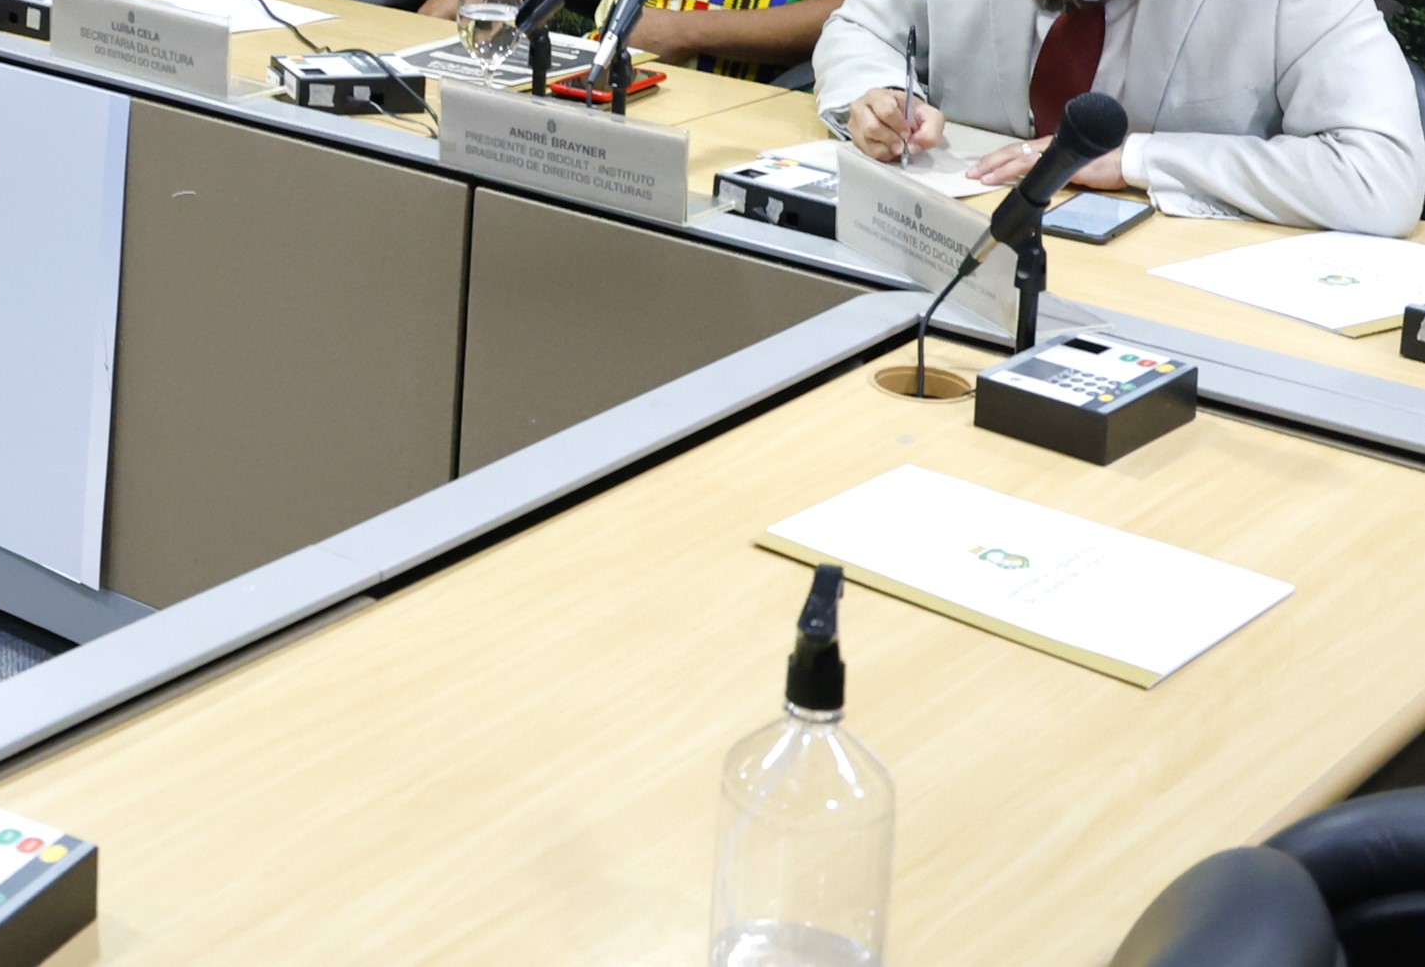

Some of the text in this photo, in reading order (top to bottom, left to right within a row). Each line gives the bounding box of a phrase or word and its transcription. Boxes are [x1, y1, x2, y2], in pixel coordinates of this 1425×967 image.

[137, 28, 160, 41] CELA
[94, 45, 106, 55] DO
[107, 49, 136, 64] ESTADO
[138, 57, 150, 67] DO
[136, 43, 150, 55] DA
[151, 47, 194, 67] CULTURA
[465, 131, 526, 155] PRESIDENTE
[529, 147, 544, 159] DO
[598, 165, 655, 187] INSTITUTO
[509, 127, 606, 159] ANDRÉ BRAYNER
[466, 144, 653, 200] BRASILEIRO DE DIREITOS CULTURAIS
[872, 216, 918, 248] PRESIDENTE
[920, 241, 931, 255] DO
